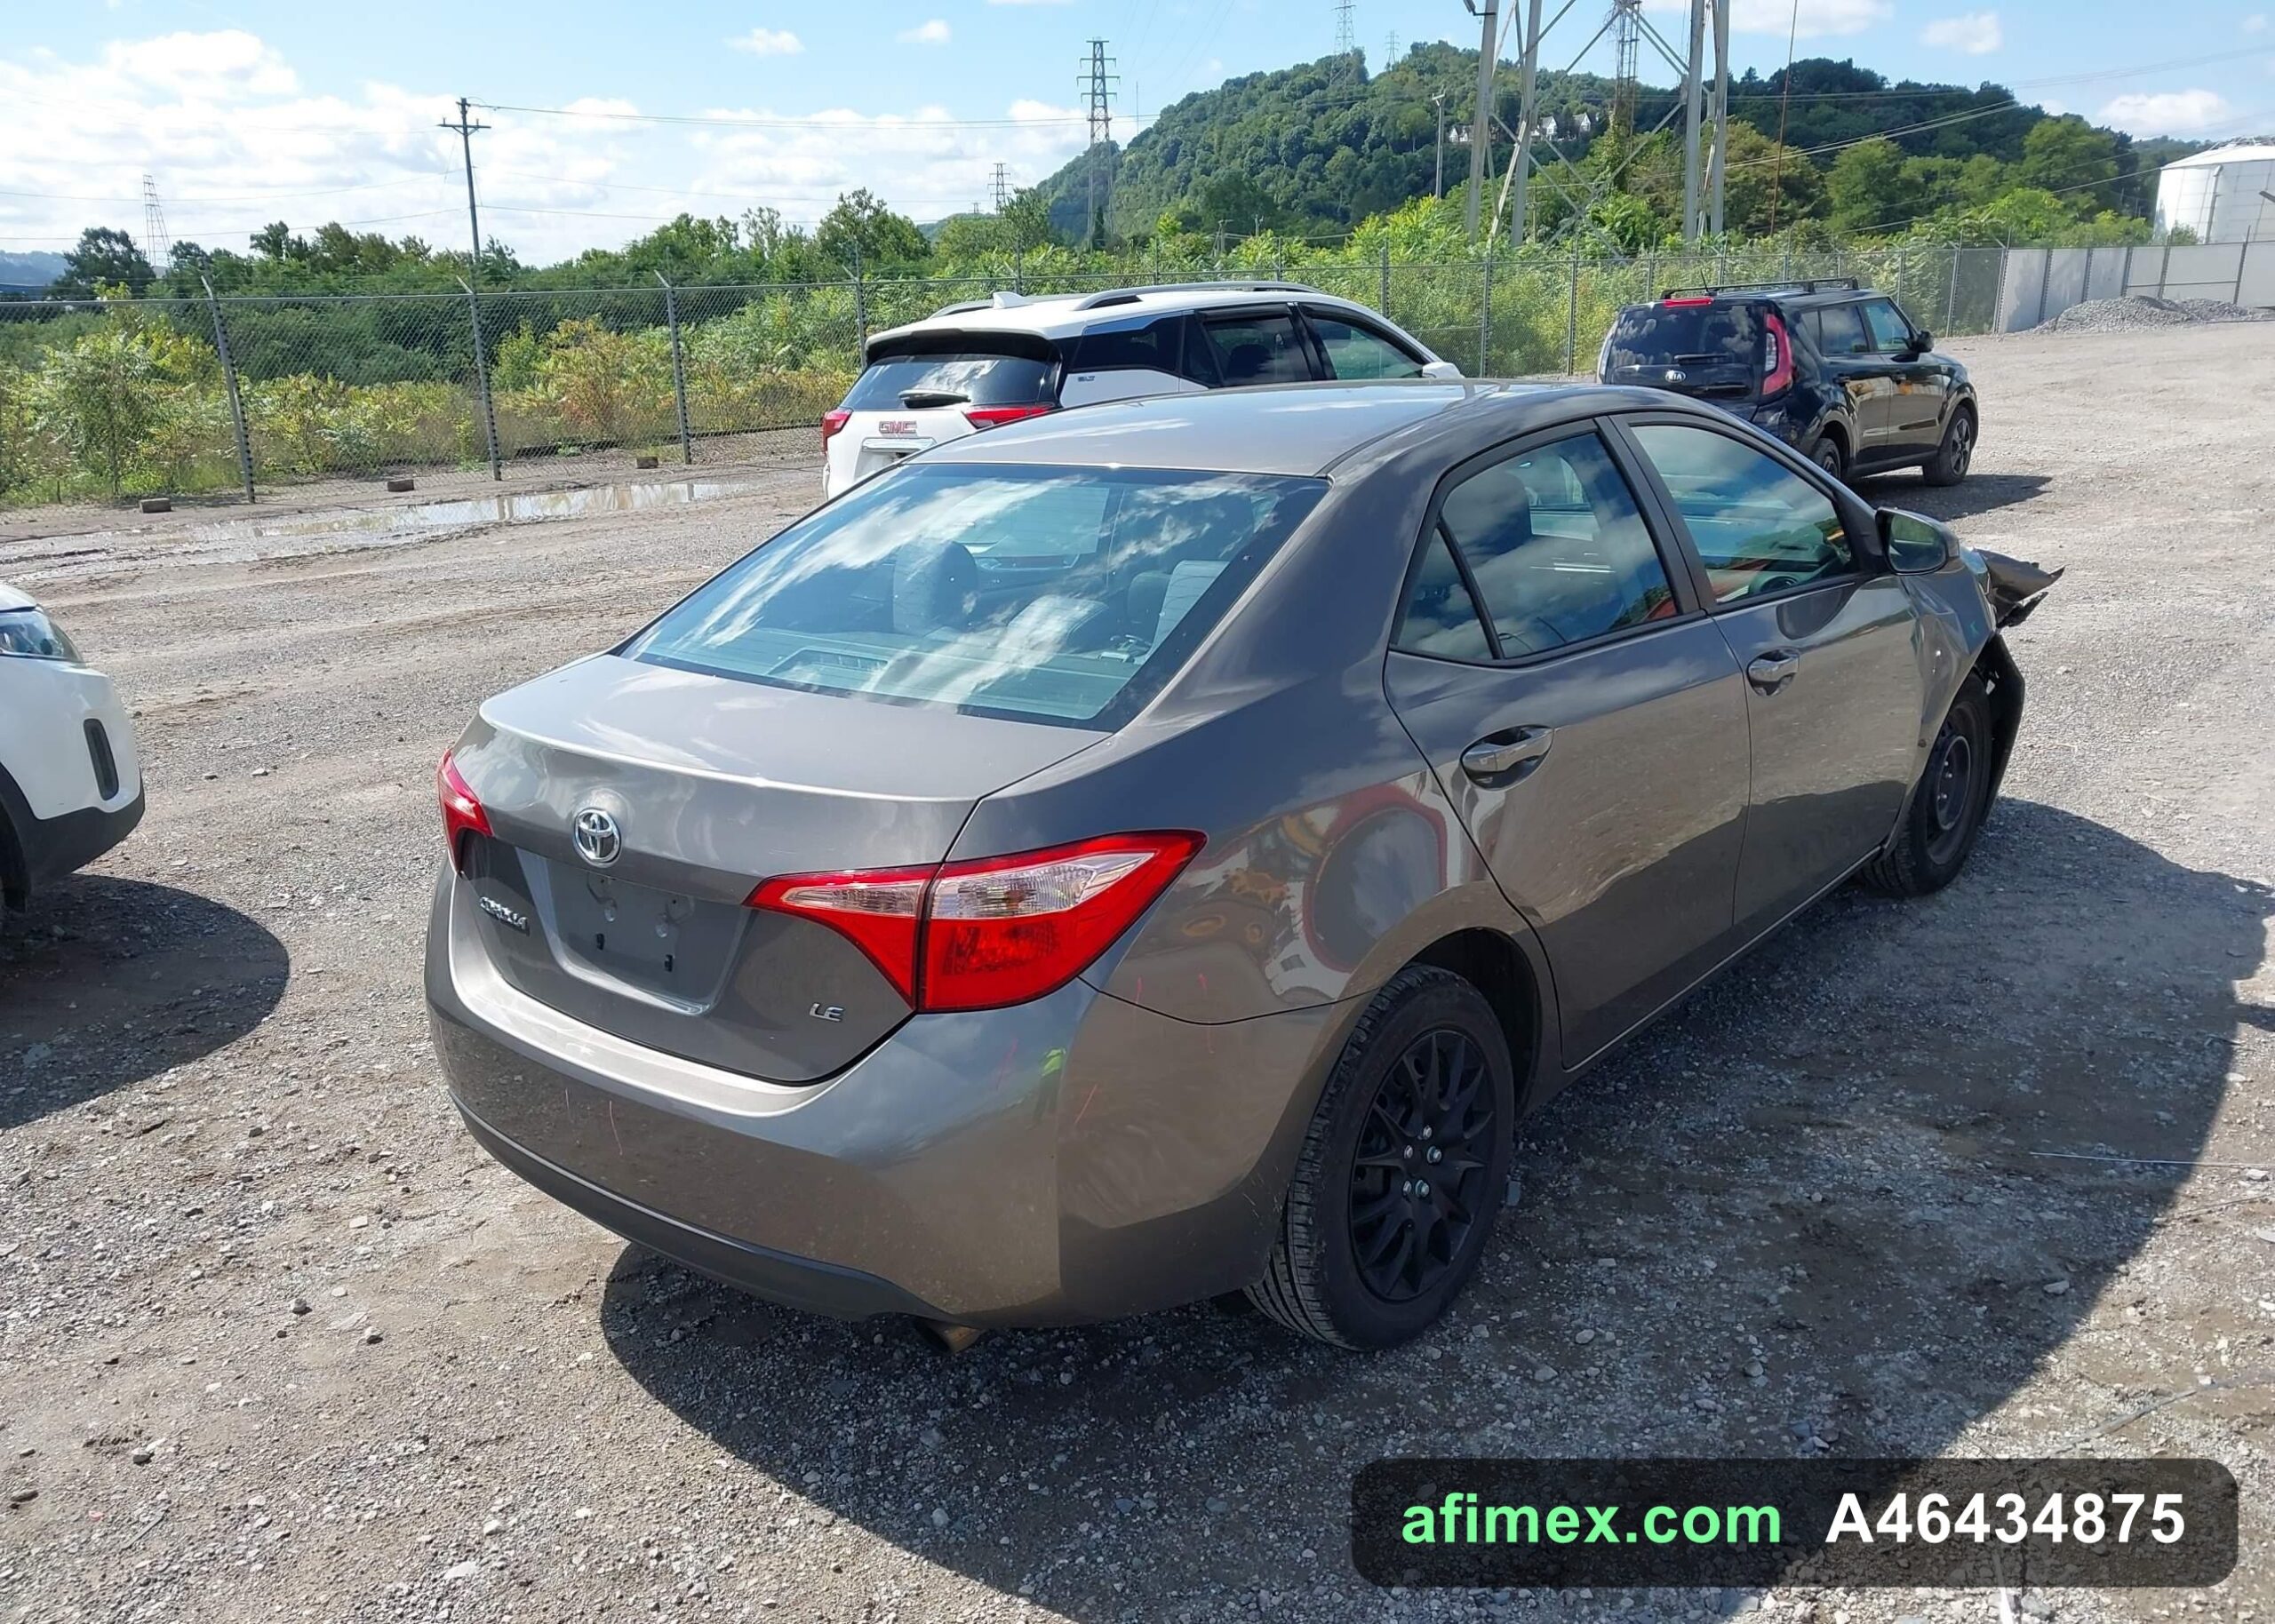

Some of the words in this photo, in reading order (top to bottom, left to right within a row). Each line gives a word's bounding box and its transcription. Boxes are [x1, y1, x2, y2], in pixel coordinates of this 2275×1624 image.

[1667, 370, 1684, 381] KIA
[879, 421, 917, 434] GMC
[809, 1003, 844, 1022] LE
